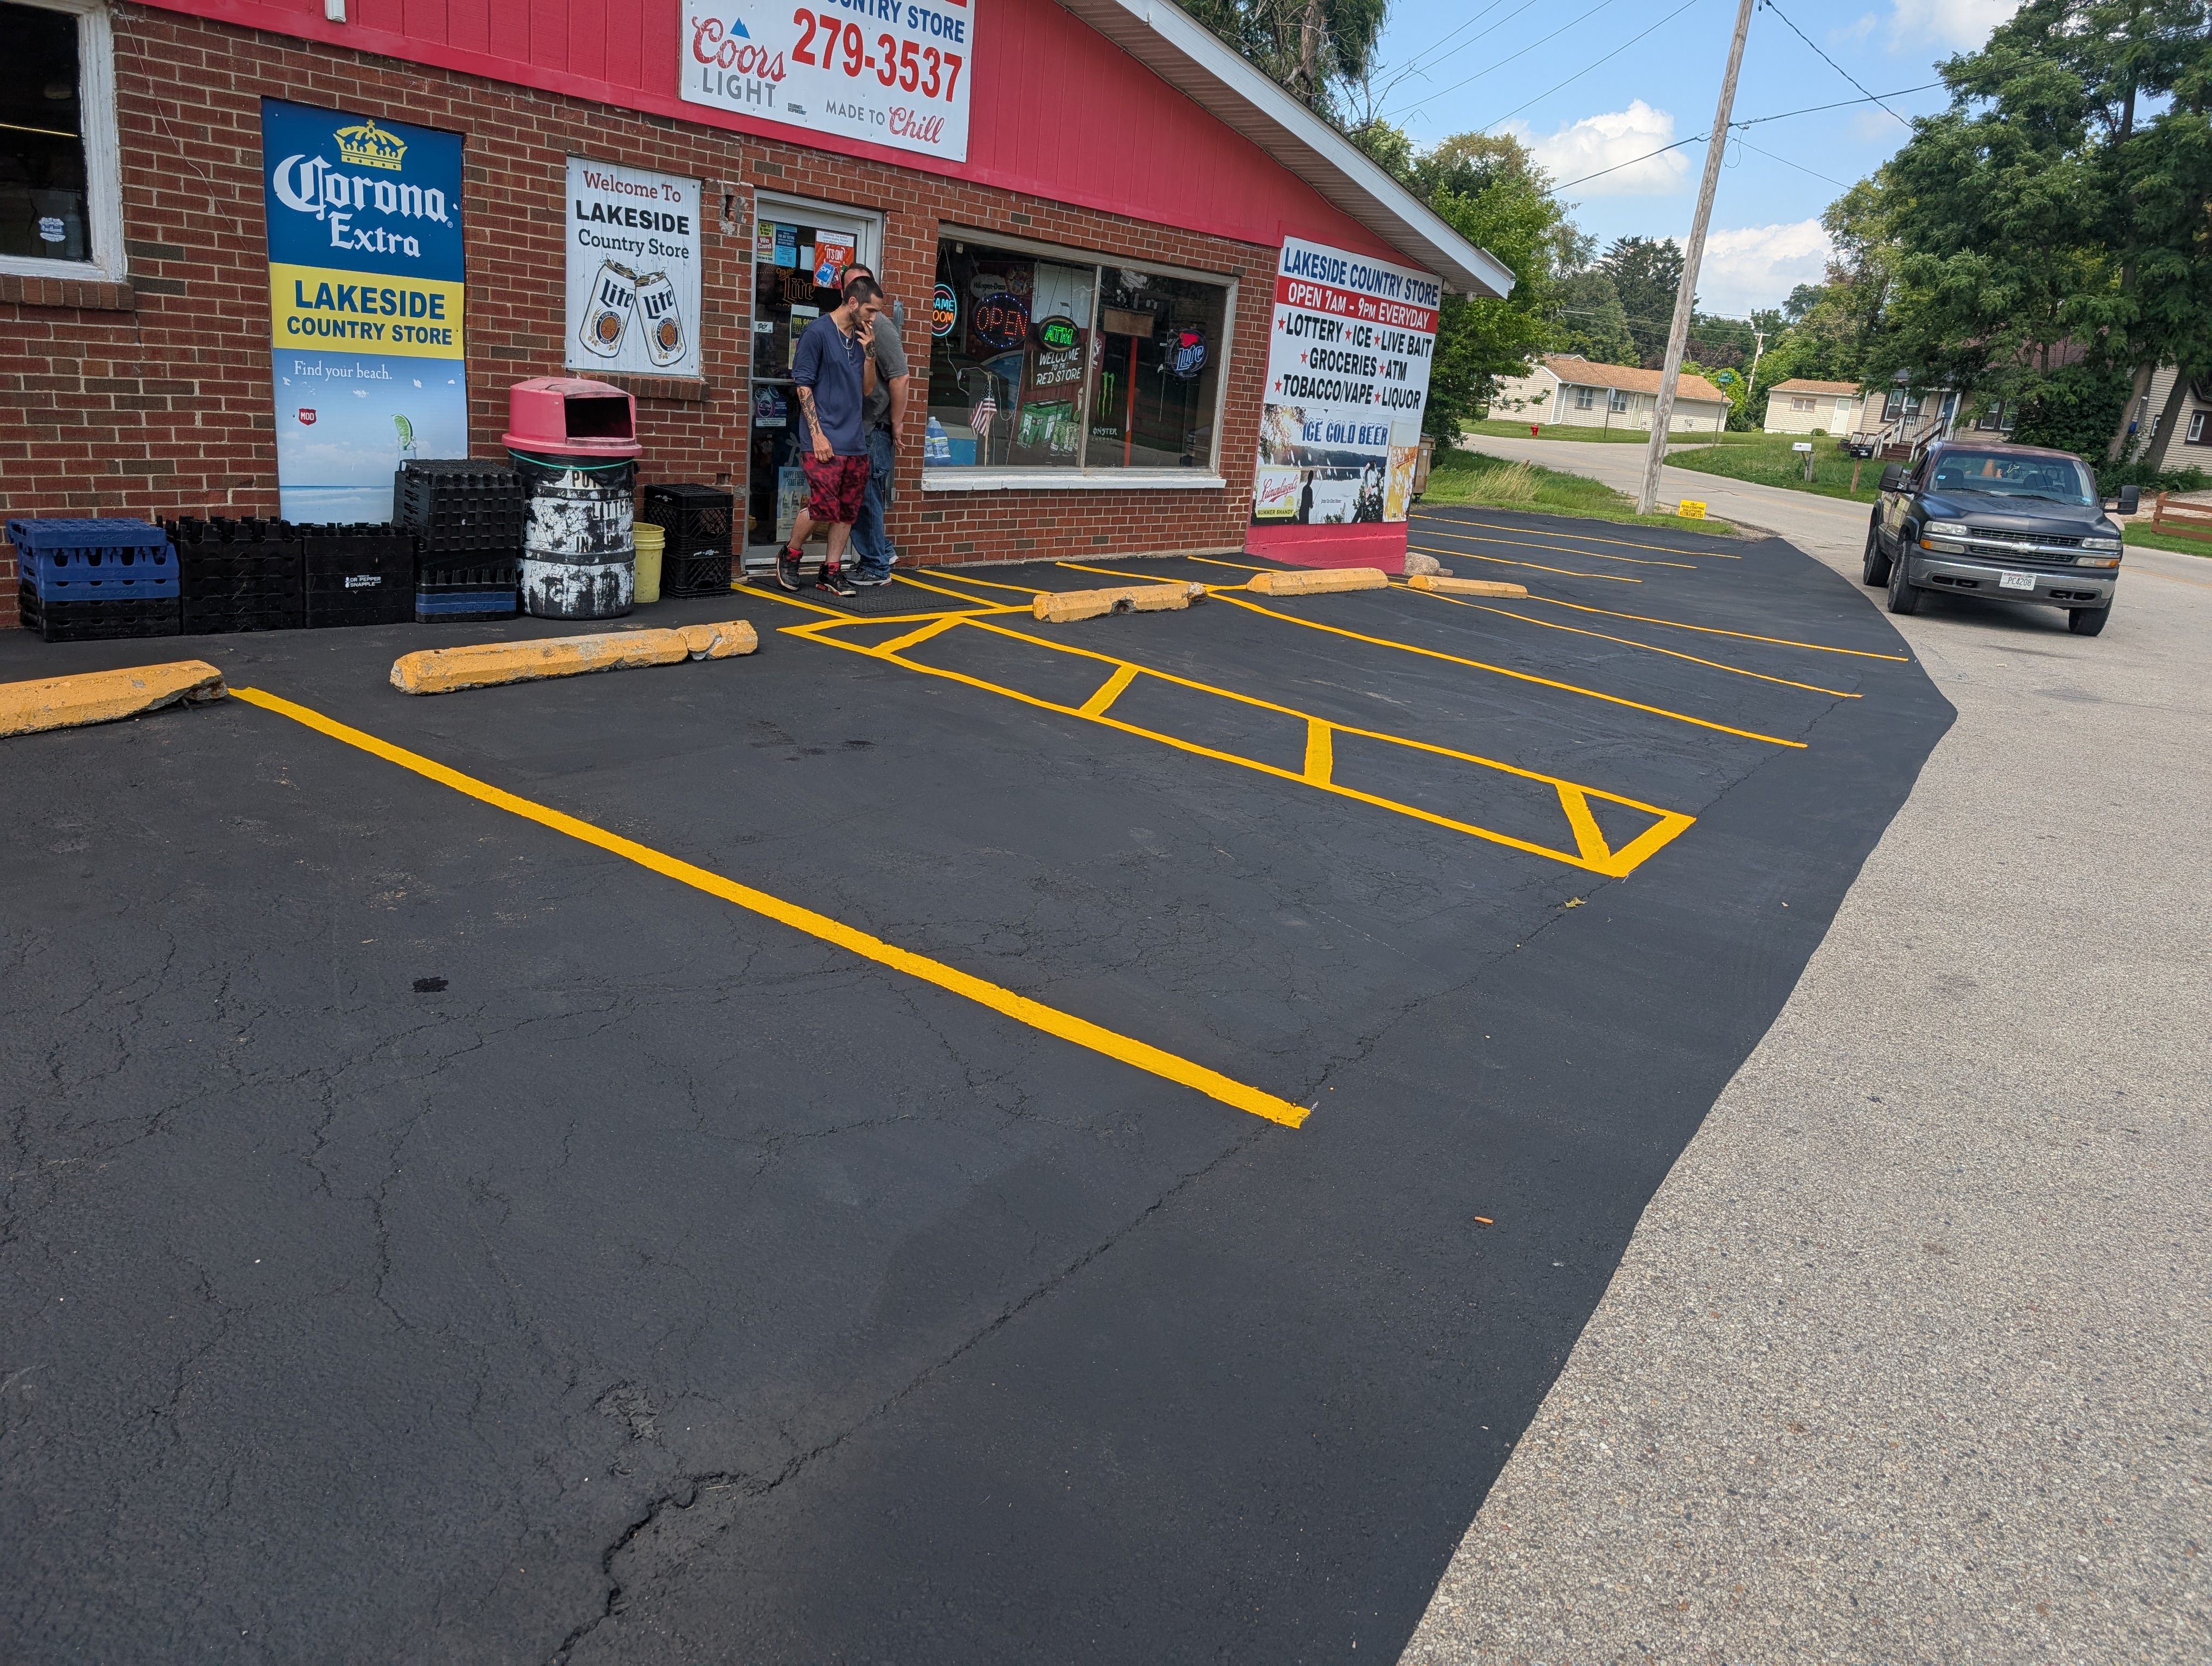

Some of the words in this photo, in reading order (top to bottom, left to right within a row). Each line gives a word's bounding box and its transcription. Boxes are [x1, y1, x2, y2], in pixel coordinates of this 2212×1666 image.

[827, 0, 902, 23] NTRY
[908, 5, 966, 44] STORE
[692, 16, 787, 82] Coors
[791, 8, 962, 103] 279-3537
[702, 67, 776, 108] LIGHT
[826, 99, 865, 122] MADE
[868, 109, 886, 126] TO
[889, 107, 945, 144] Chill
[273, 154, 449, 223] Corona
[583, 170, 658, 199] Welcome
[661, 184, 681, 203] To
[576, 200, 690, 235] LAKESIDE
[328, 211, 421, 258] Extra
[578, 228, 645, 257] Country
[648, 238, 690, 259] Store
[780, 277, 815, 304] Lite
[1284, 247, 1347, 285] LAKESIDE
[1350, 264, 1403, 298] COUNTRY
[1404, 278, 1438, 306] STORE
[295, 279, 445, 321] LAKESIDE
[599, 277, 634, 308] Lite
[641, 290, 674, 319] Lite
[1288, 282, 1322, 308] OPEN
[1325, 291, 1346, 313] 7AM
[1358, 298, 1376, 319] 9PM
[1378, 302, 1430, 330] EVERYDAY
[287, 316, 386, 341] COUNTRY
[392, 325, 453, 346] STORE
[933, 310, 954, 324] OOM
[976, 306, 1028, 336] OPEN
[1044, 325, 1073, 347] ATM
[1286, 312, 1344, 343] LOTTERY
[1352, 325, 1372, 348] ICE
[1381, 330, 1405, 354] LIVE
[1407, 335, 1432, 358] BAIT
[294, 360, 323, 376] Find
[325, 364, 353, 382] your
[357, 362, 393, 380] beach.
[1039, 348, 1080, 366] WELCOME
[1175, 345, 1204, 370] Lite
[1309, 347, 1377, 377] GROCERIES
[1385, 359, 1407, 381] ATM
[1036, 372, 1054, 386] RED
[1056, 367, 1082, 382] STORE
[1283, 374, 1374, 405] TOBACCO/VAPE
[1381, 387, 1421, 411] LIQUOR
[300, 411, 314, 421] MOD
[1093, 427, 1117, 435] ONSTER
[1302, 417, 1323, 442] ICE
[1326, 419, 1355, 444] COLD
[1358, 421, 1388, 446] BEER
[1257, 474, 1298, 505] Leinenkugel's
[592, 499, 631, 520] LITTER
[2007, 577, 2032, 586] PC4208
